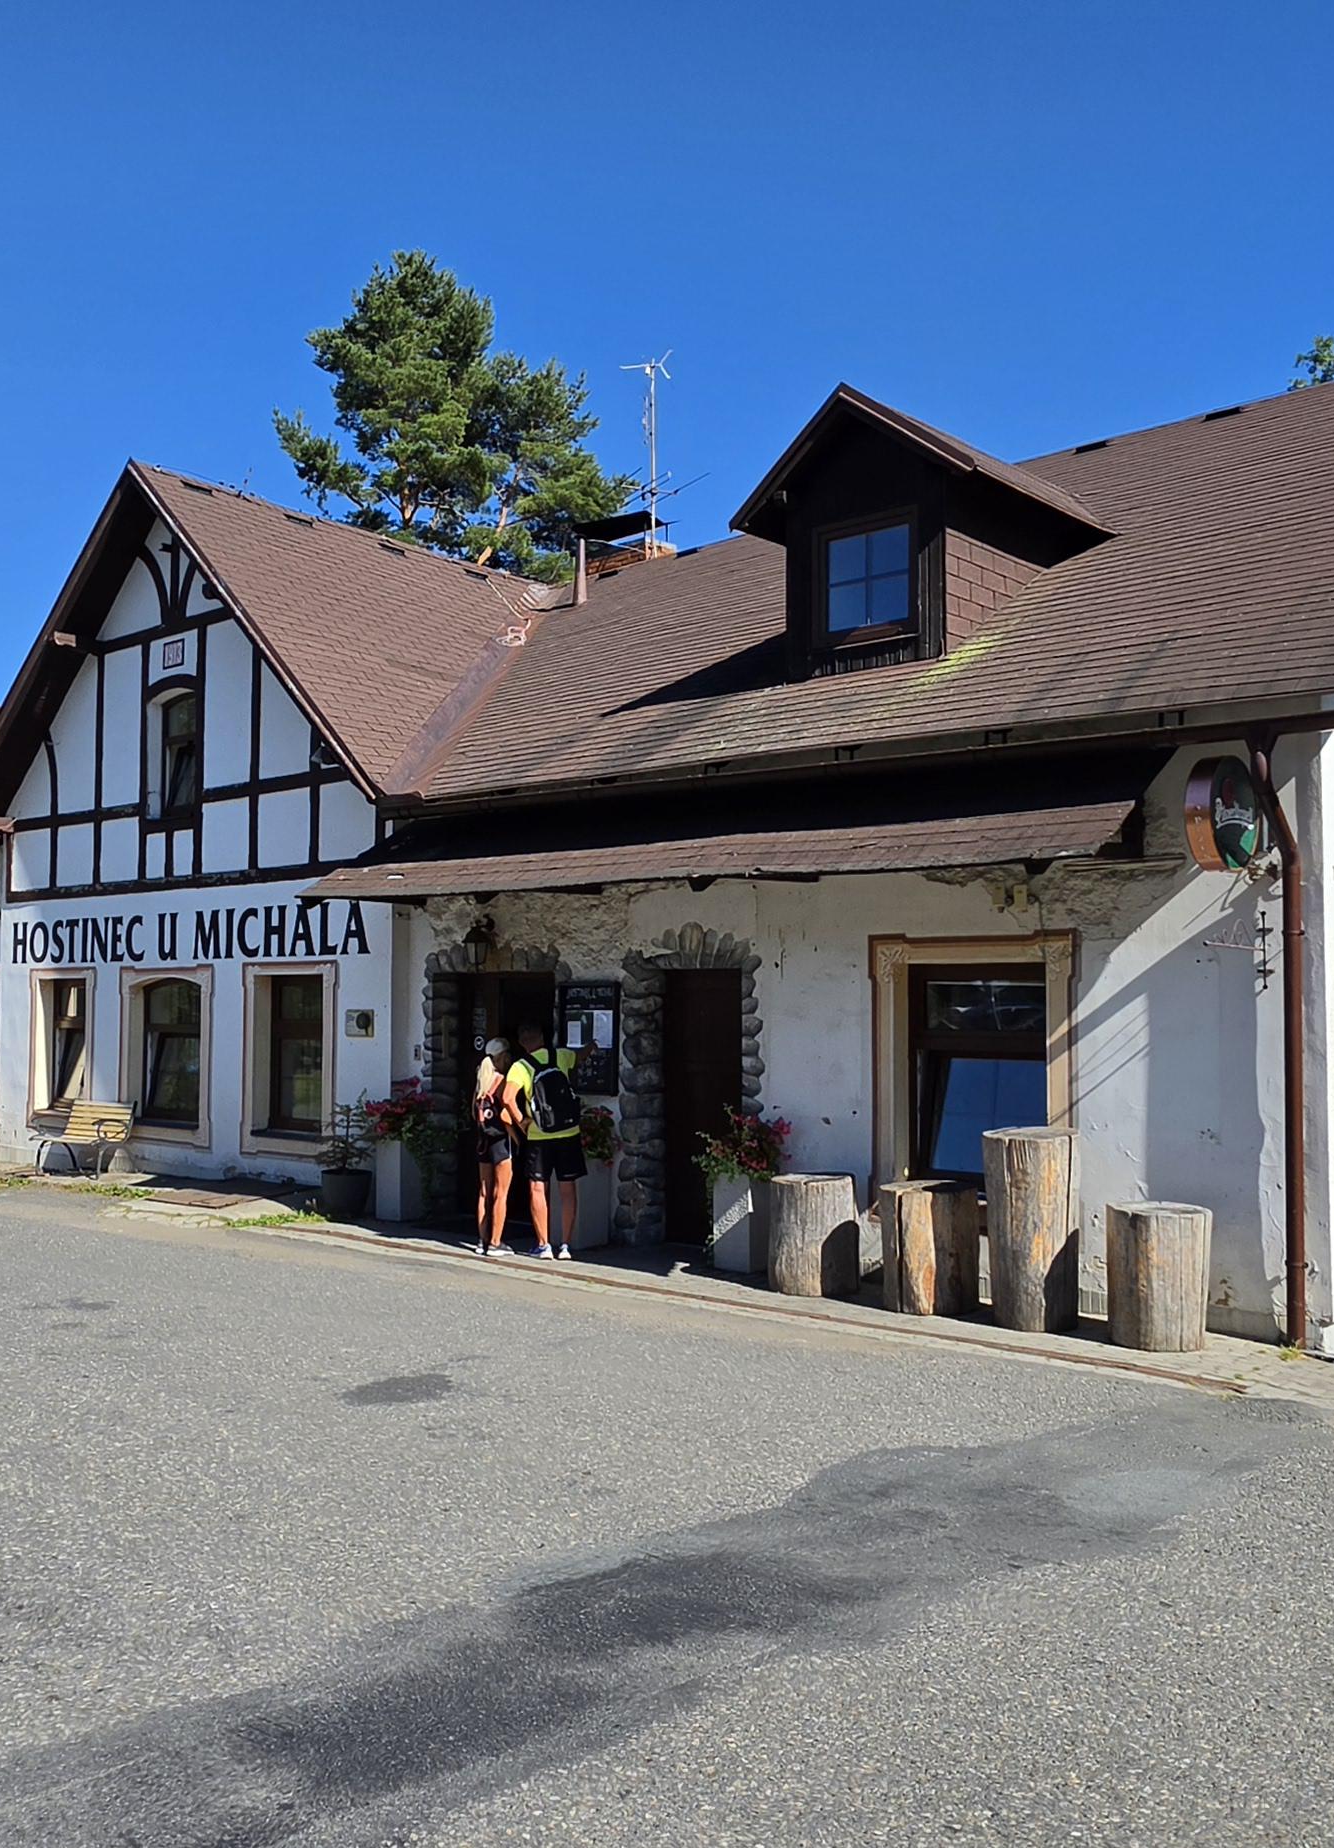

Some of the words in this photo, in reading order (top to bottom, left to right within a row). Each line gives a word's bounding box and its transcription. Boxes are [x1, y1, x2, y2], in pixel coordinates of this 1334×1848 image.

[12, 915, 144, 965] HOSTINEC
[157, 912, 179, 961] U
[192, 899, 371, 960] MICHALA
